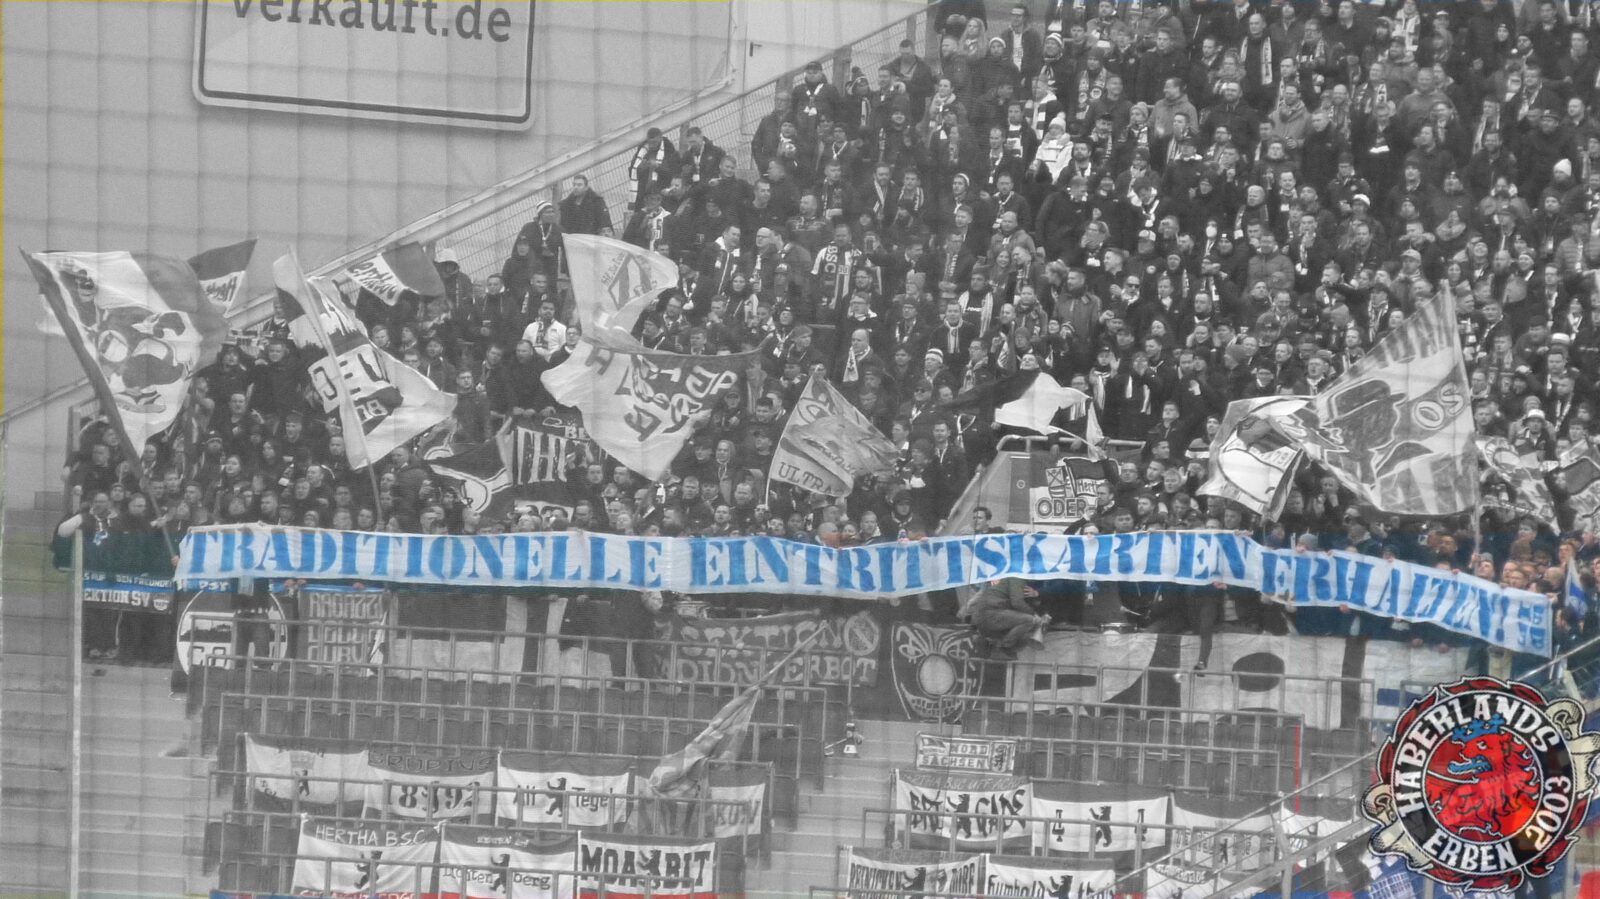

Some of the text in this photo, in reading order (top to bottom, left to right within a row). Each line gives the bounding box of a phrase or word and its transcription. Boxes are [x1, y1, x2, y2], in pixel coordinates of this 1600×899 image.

[186, 530, 1510, 644] TRADITIONELLE EINTRITTSKARTEN ERHALTEN!
[315, 826, 379, 846] HERTHA
